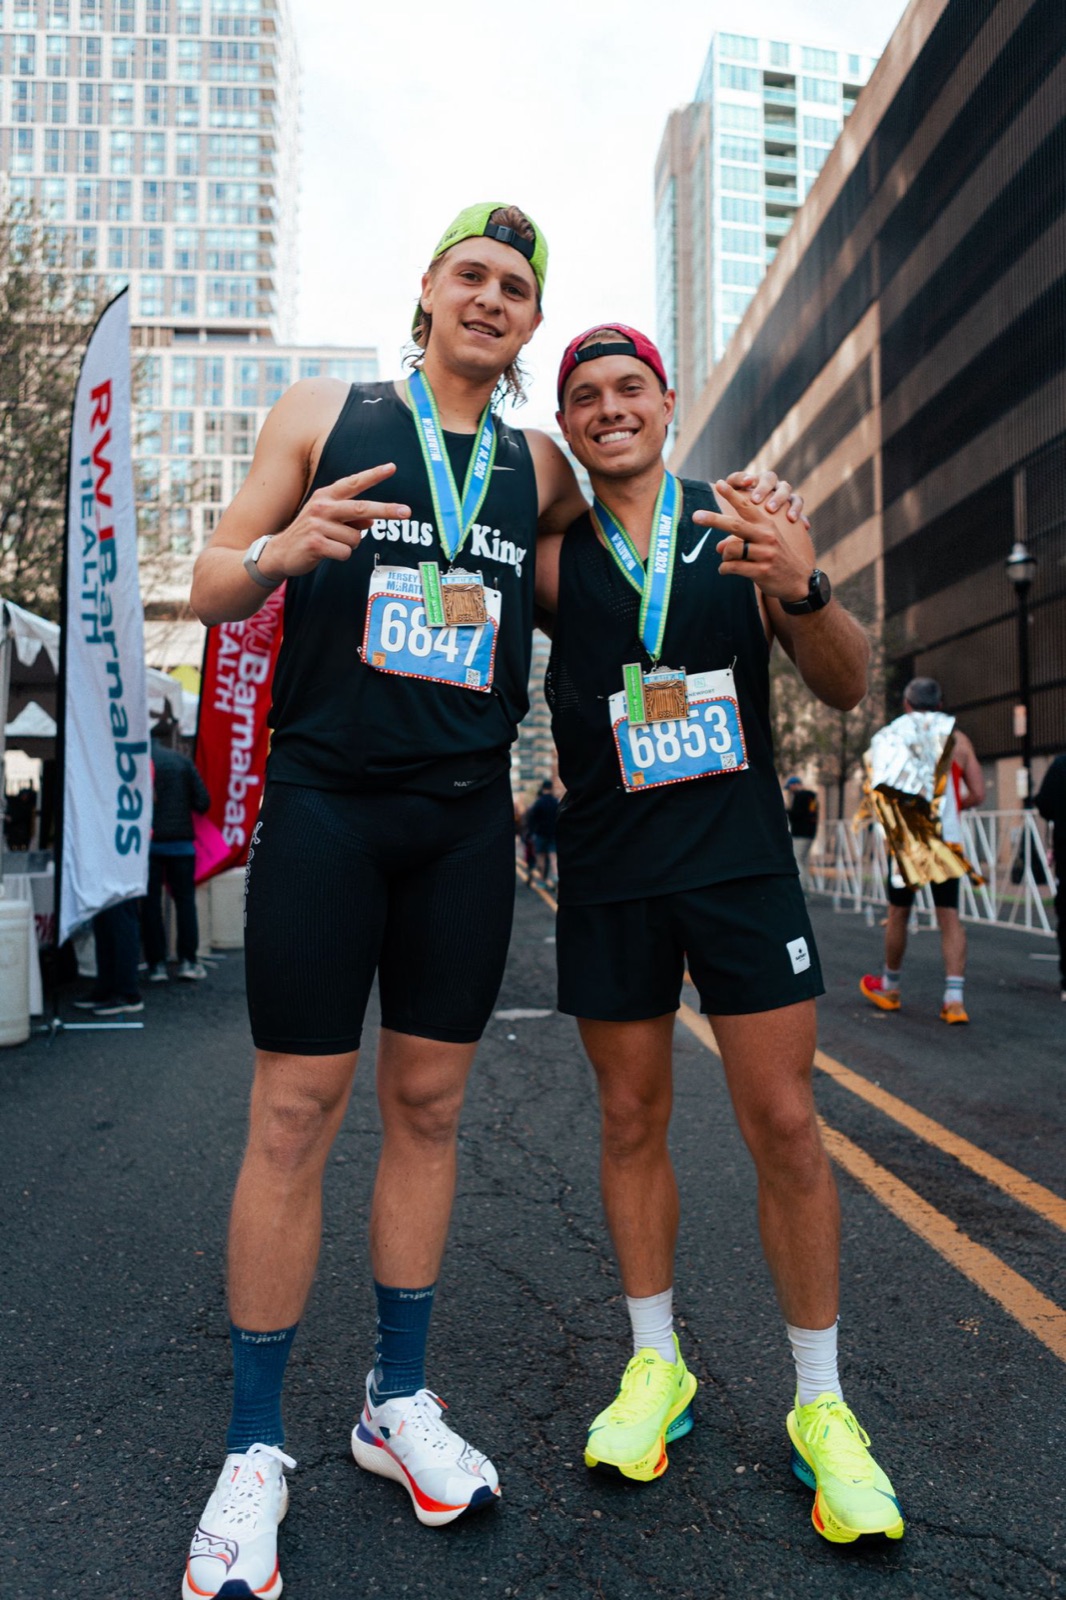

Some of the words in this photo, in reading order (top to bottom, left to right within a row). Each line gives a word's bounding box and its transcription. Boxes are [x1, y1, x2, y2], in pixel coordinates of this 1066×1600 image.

[80, 456, 103, 645] HEALTH
[361, 519, 434, 547] esus
[471, 524, 527, 578] King
[654, 538, 671, 574] 14.2024
[658, 513, 673, 537] APRIL
[387, 571, 418, 583] JERSEY
[380, 601, 485, 668] 6847
[214, 621, 246, 713] EALTH
[221, 581, 285, 847] WJBarnabas
[628, 705, 732, 769] 6853
